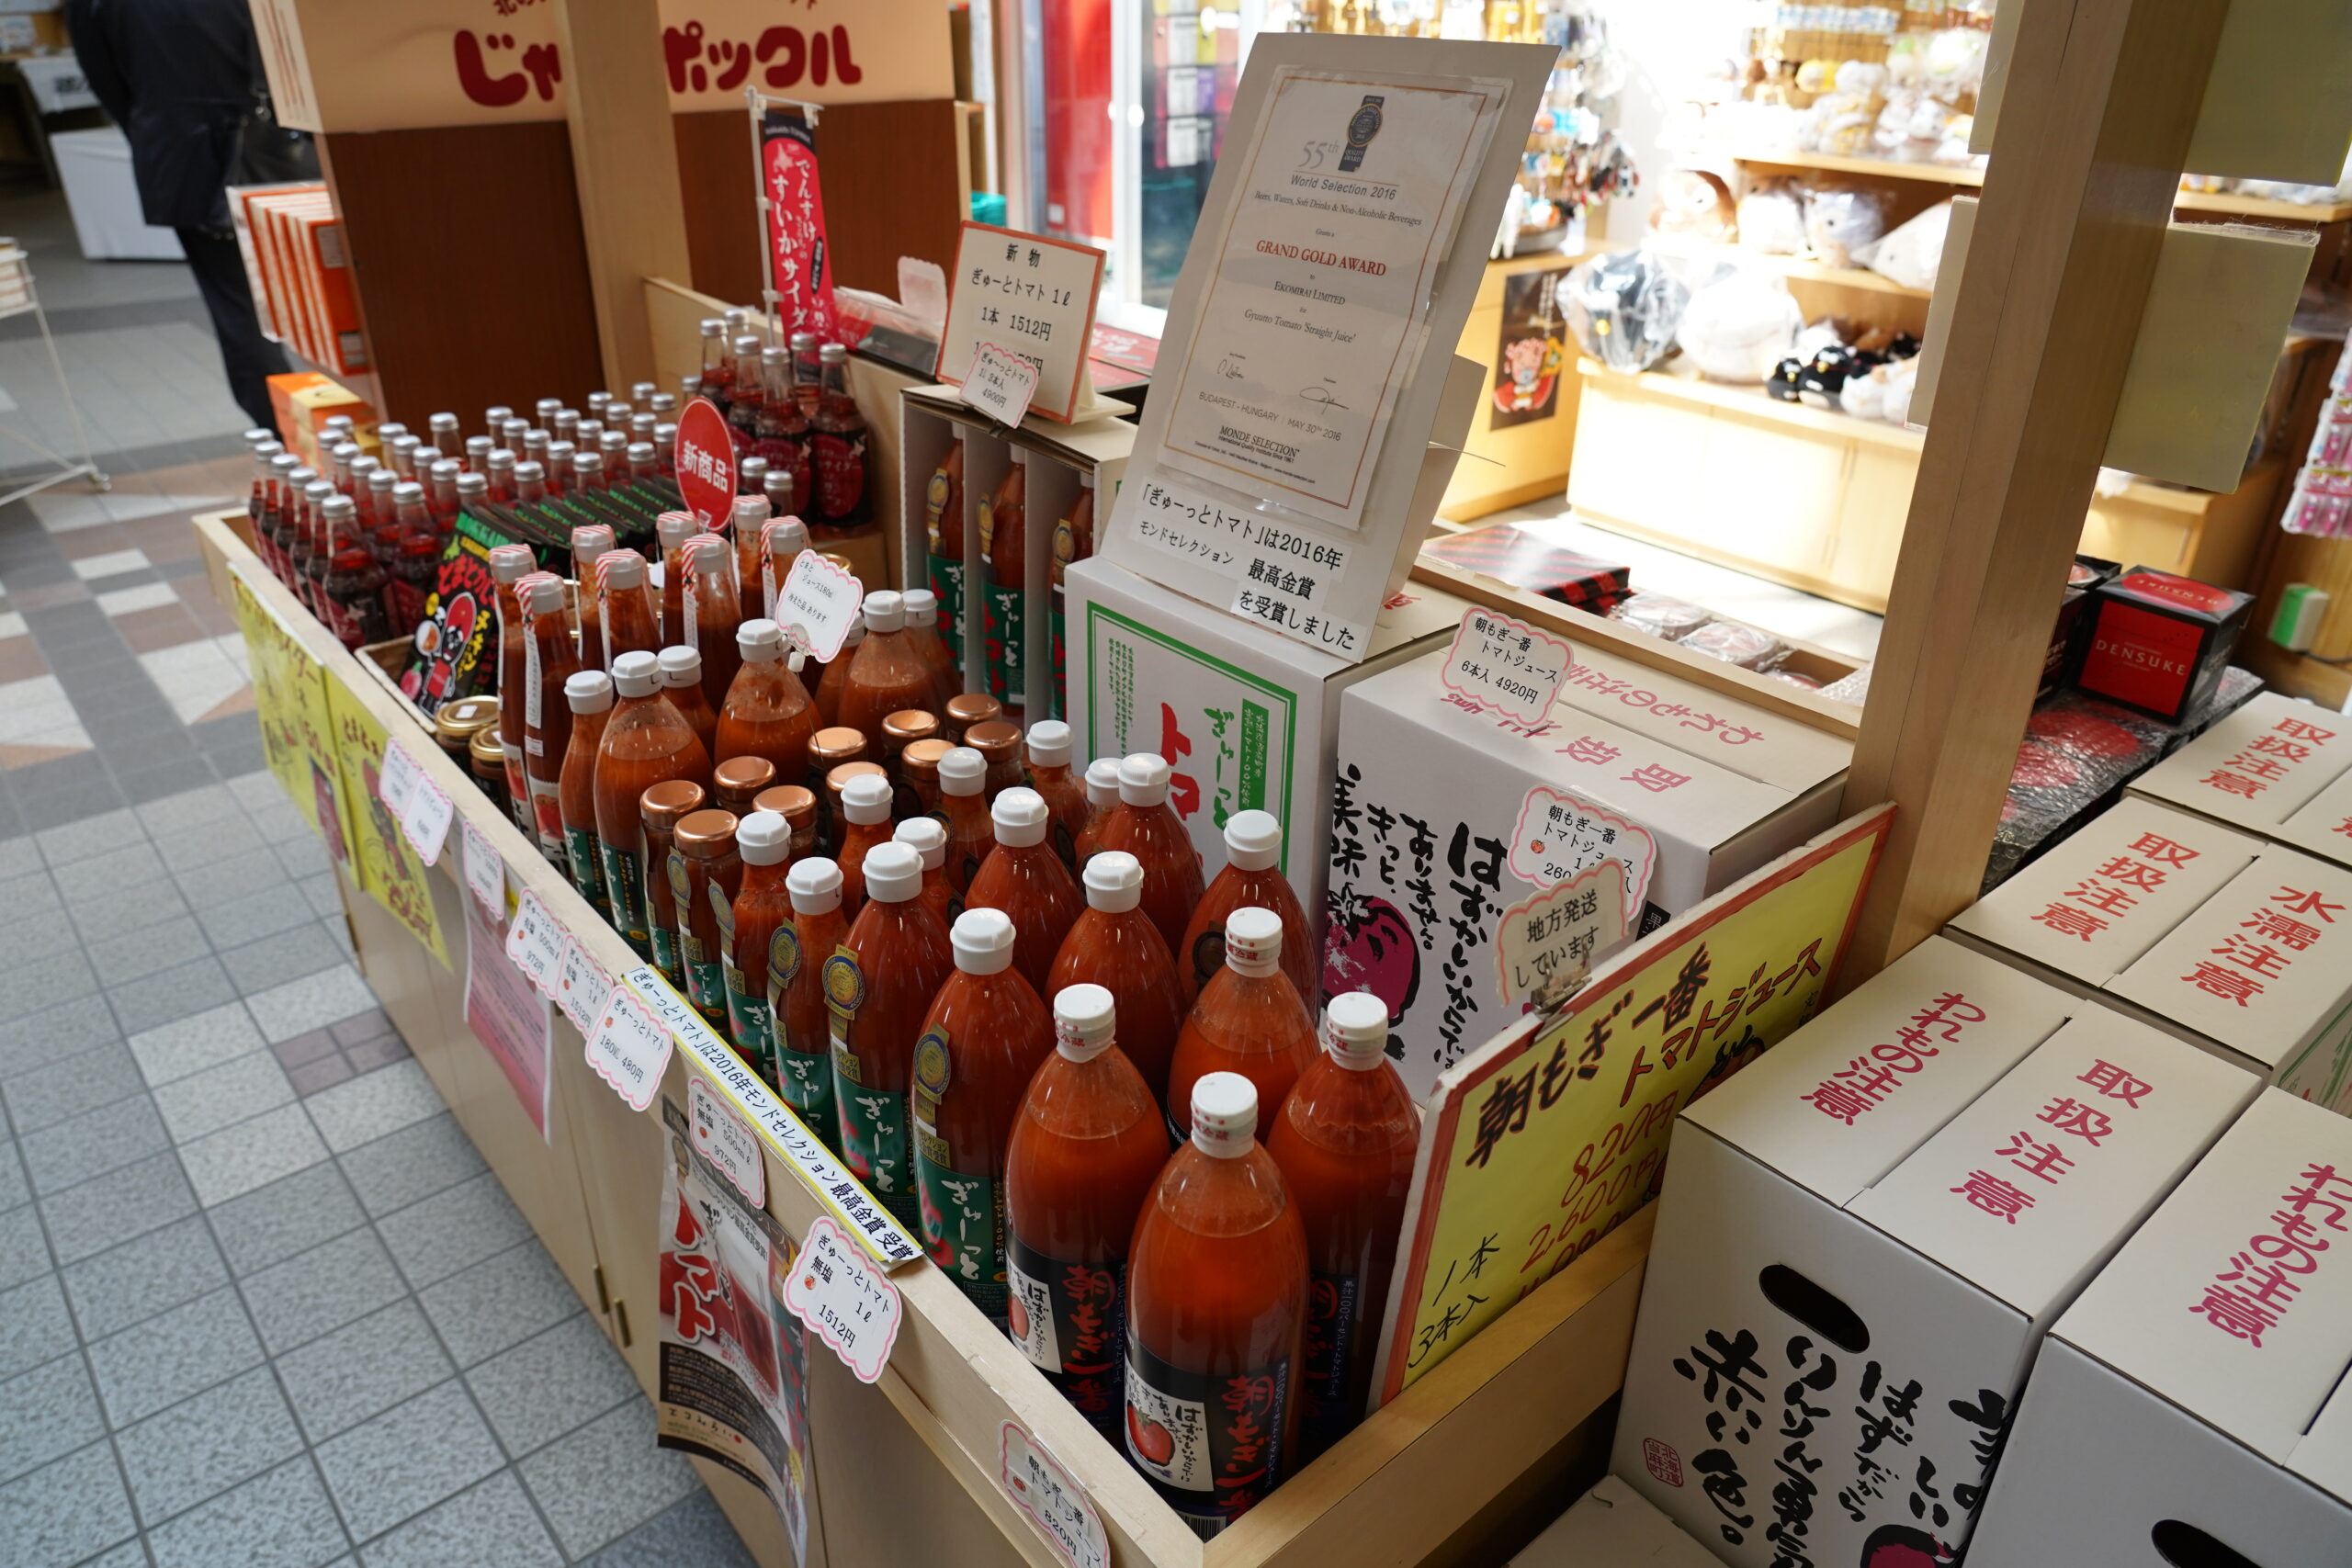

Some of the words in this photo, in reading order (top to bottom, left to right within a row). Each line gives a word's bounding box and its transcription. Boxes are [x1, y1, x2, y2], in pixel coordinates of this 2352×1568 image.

[1273, 193, 1295, 206] Waters,
[1295, 197, 1308, 208] Soft
[1309, 197, 1331, 212] Drinks
[1340, 204, 1387, 220] Non-Alcoholic
[1388, 211, 1423, 227] Beverages
[1290, 175, 1317, 189] World
[1320, 178, 1367, 197] Selection
[1371, 186, 1396, 201] 2016
[772, 174, 808, 330] すいかサイダ
[1256, 239, 1299, 259] GRAND
[1301, 247, 1337, 267] GOLD
[1339, 257, 1387, 276] AWARD
[1313, 288, 1346, 306] LIMITED
[1010, 314, 1052, 342] 1512円
[1273, 315, 1302, 332] Tomato
[982, 389, 1008, 409] 4900円
[1198, 391, 1237, 410] BUDAPEST
[1241, 404, 1280, 423] HUNGARY
[1287, 418, 1305, 432] MAY
[1322, 428, 1341, 442] 2016
[1219, 425, 1250, 445] MONDE
[682, 439, 729, 494] 新商品
[1139, 520, 1235, 566] モンドセレクション
[1248, 557, 1316, 601] 最高金賞
[1239, 589, 1355, 650] を受賞しました
[1474, 616, 1532, 653] 朝もぎ一番
[1480, 639, 1557, 683] トマトジュース
[2096, 638, 2188, 677] DENSUKE
[1461, 660, 1489, 684] 6本入
[1495, 673, 1539, 705] 4920円
[2199, 716, 2337, 800] 取扱注意
[1544, 821, 1634, 874] トマトジュス
[1547, 804, 1616, 846] 朝もぎ一番
[2030, 830, 2201, 943] 取扱注意
[1526, 888, 1599, 944] 地方発送
[1515, 924, 1600, 989] しています
[2180, 884, 2348, 1010] 水濡注意
[1619, 937, 1824, 1108] トマトジュース
[621, 1056, 644, 1084] 480円
[1465, 942, 1716, 1169] 朝もぎ一番
[1801, 991, 1988, 1127] われもの注意
[714, 1144, 736, 1175] 972円
[1561, 1089, 1679, 1210] 820円
[1949, 1058, 2154, 1225] 取扱注意
[810, 1255, 834, 1285] 無塩
[818, 1233, 890, 1314] ぎゅーっとトマト
[2188, 1162, 2352, 1349] われもの注意
[818, 1303, 857, 1349] 1512円
[1028, 1454, 1085, 1527] 朝もぎ一番
[1044, 1509, 1078, 1557] 820円
